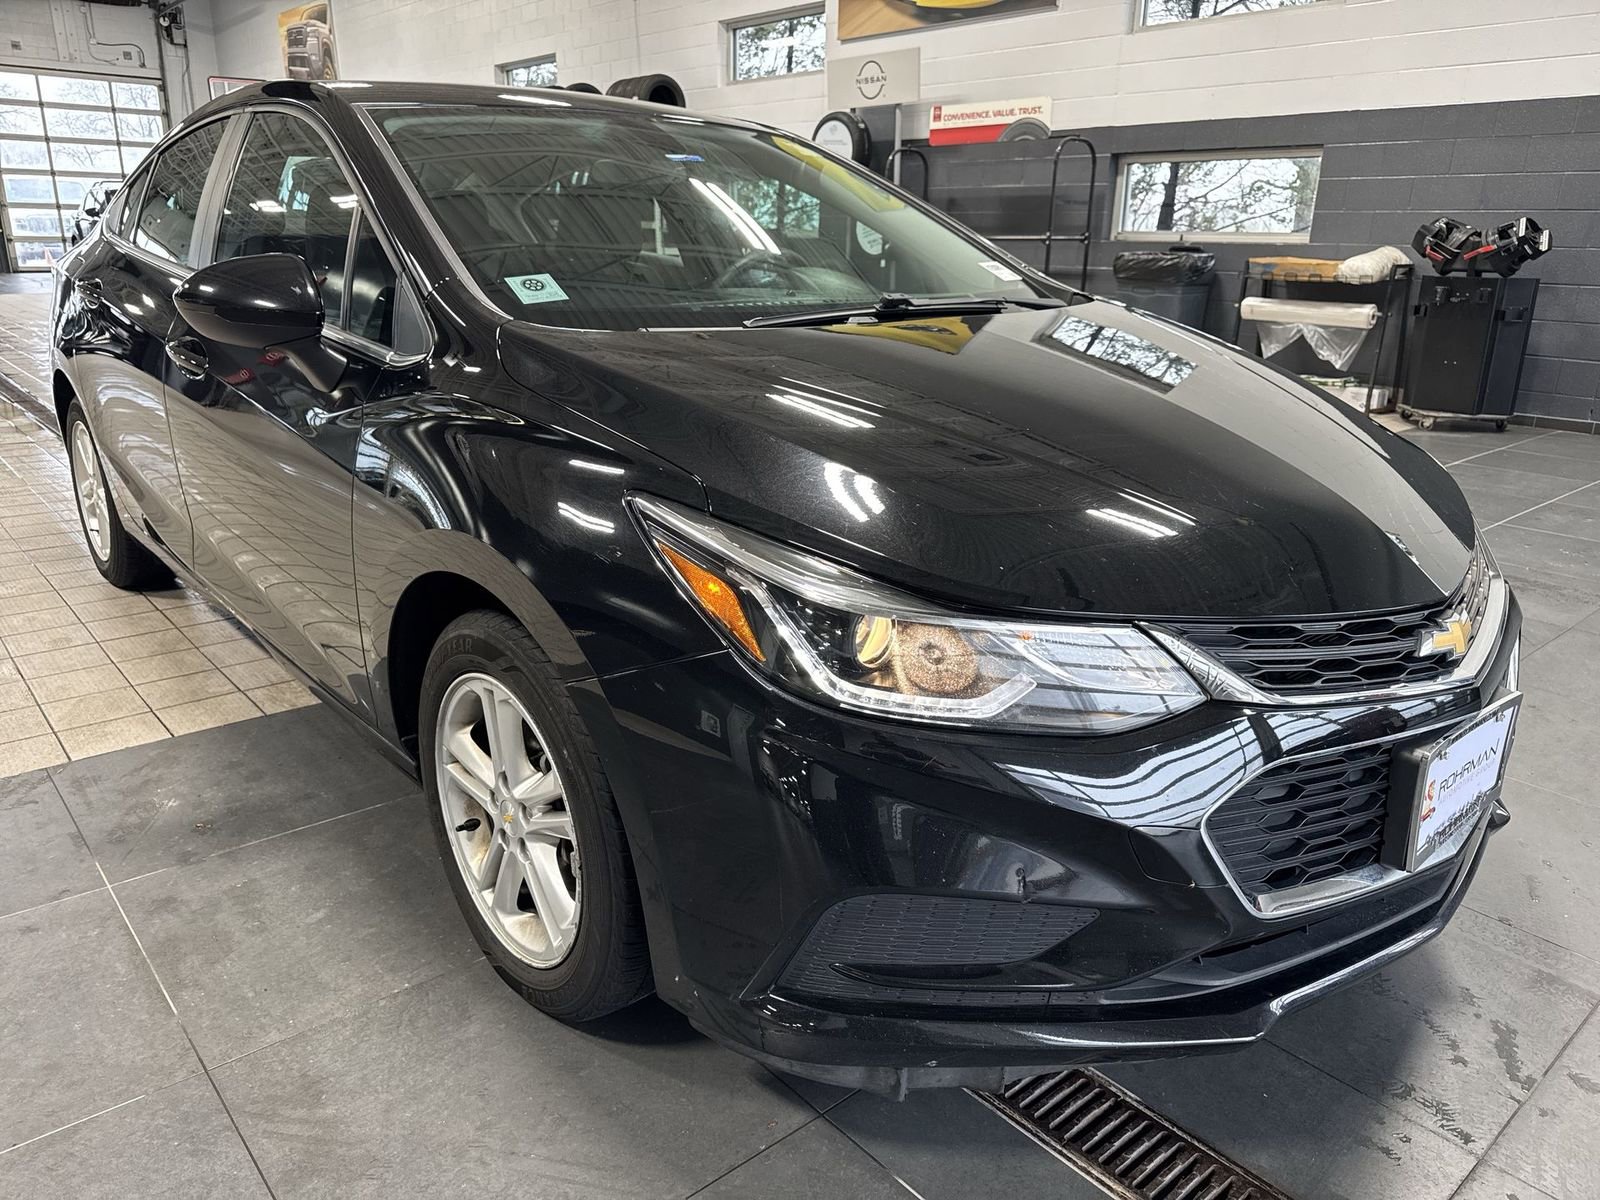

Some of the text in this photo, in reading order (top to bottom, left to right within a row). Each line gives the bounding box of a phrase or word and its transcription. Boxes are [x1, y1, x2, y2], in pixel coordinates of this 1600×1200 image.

[856, 75, 887, 85] NISSAN
[943, 111, 992, 121] CONVENIENCE.
[992, 108, 1017, 117] VALUE.
[1018, 106, 1044, 115] TRUST.
[1437, 737, 1500, 801] ROHRMAN
